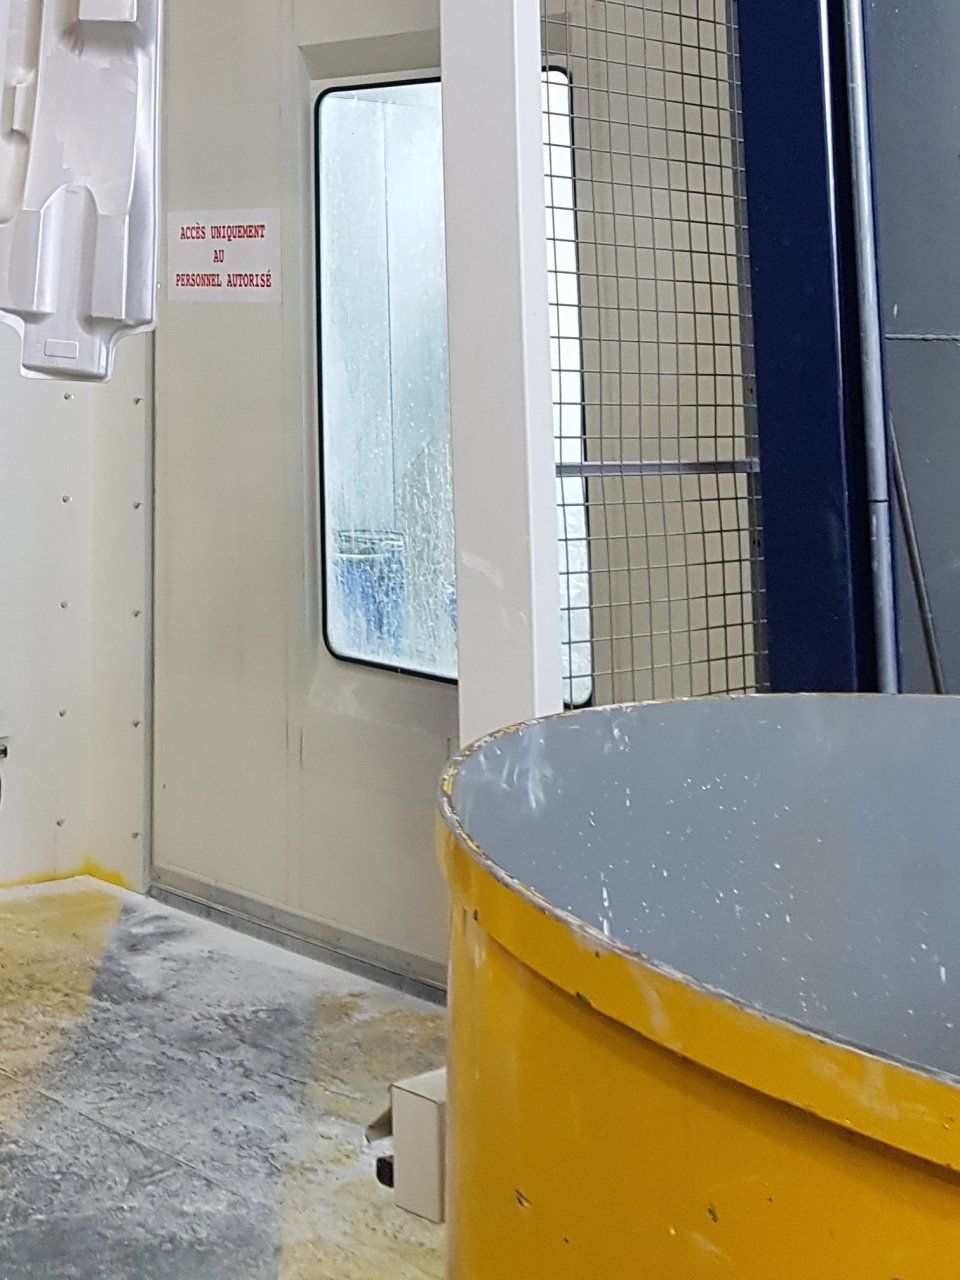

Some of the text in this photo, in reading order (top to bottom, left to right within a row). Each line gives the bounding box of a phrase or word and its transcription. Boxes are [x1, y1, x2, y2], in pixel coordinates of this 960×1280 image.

[180, 222, 266, 242] ACCÈS UNIQUEMENT
[213, 249, 225, 263] AU
[175, 269, 272, 288] PERSONNEL AUTORISÉ
